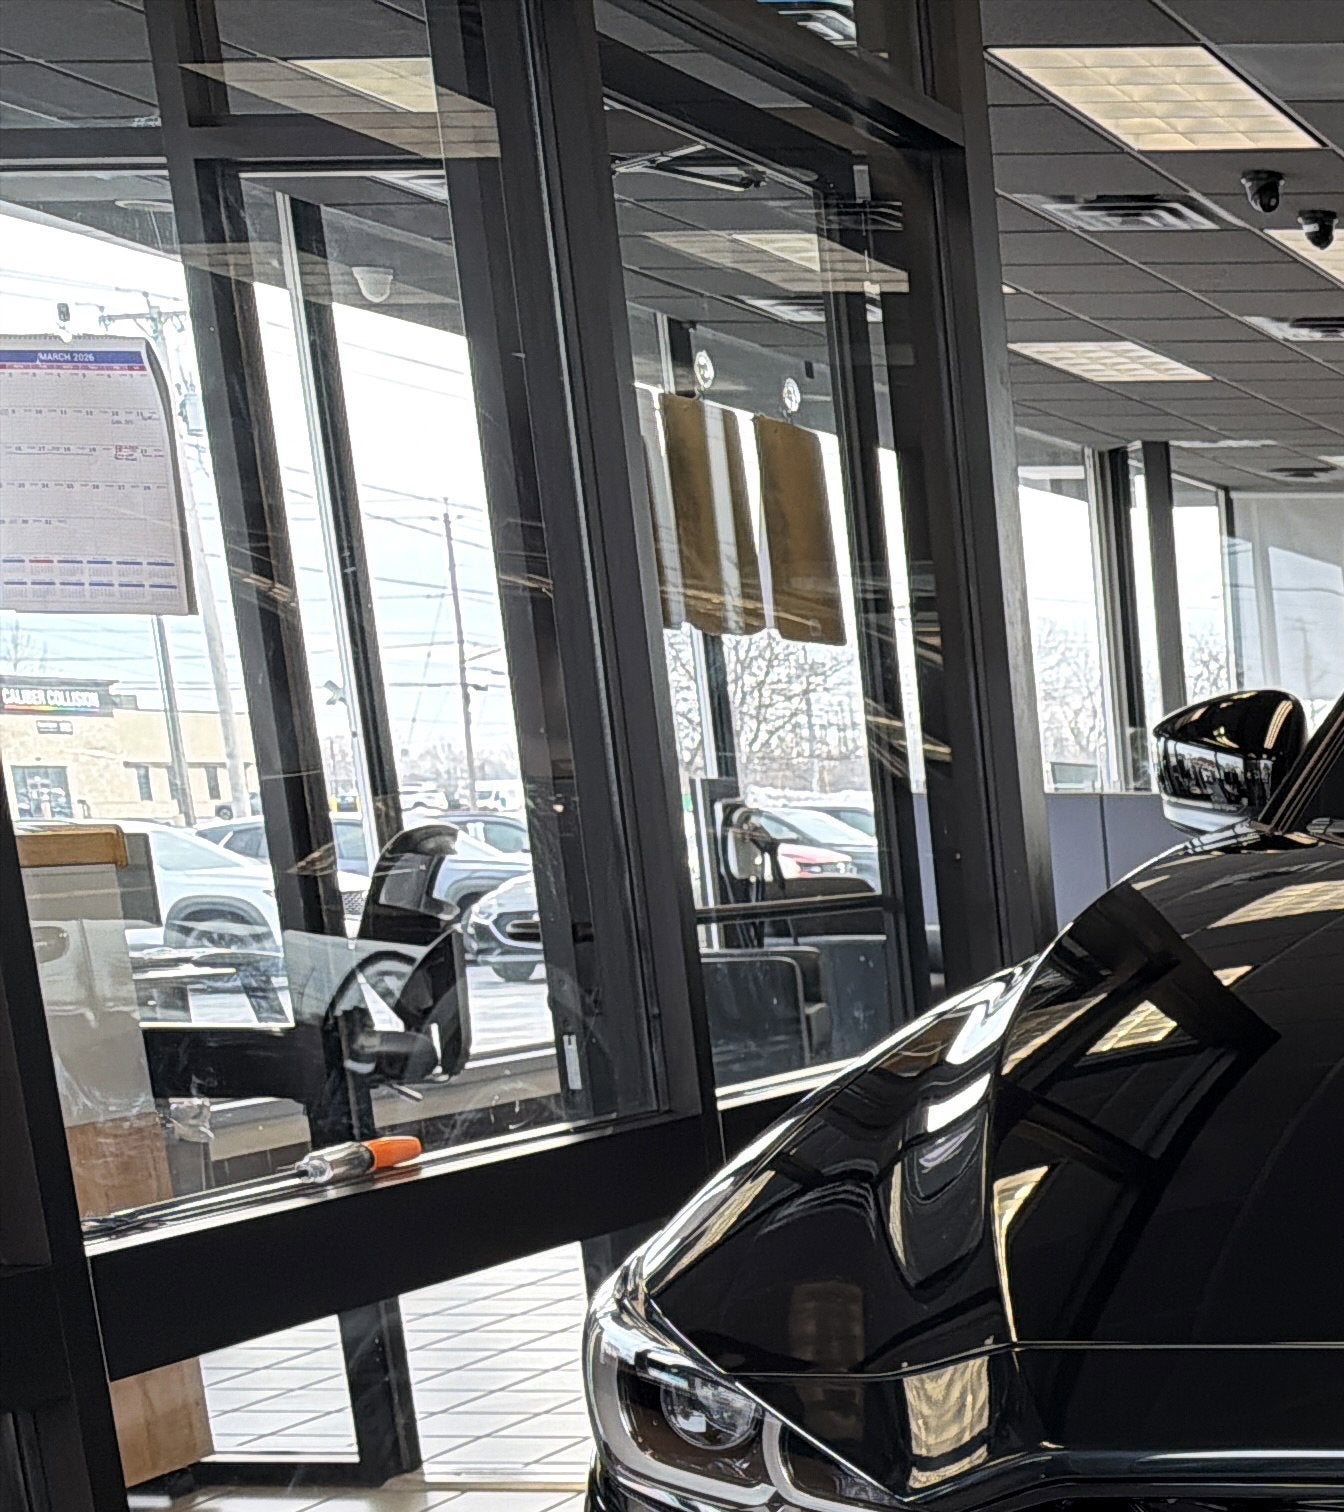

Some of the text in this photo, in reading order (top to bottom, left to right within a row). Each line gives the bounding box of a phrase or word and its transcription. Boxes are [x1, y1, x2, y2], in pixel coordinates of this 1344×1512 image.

[38, 352, 95, 362] MARCH 2026
[46, 688, 100, 708] COLLISION
